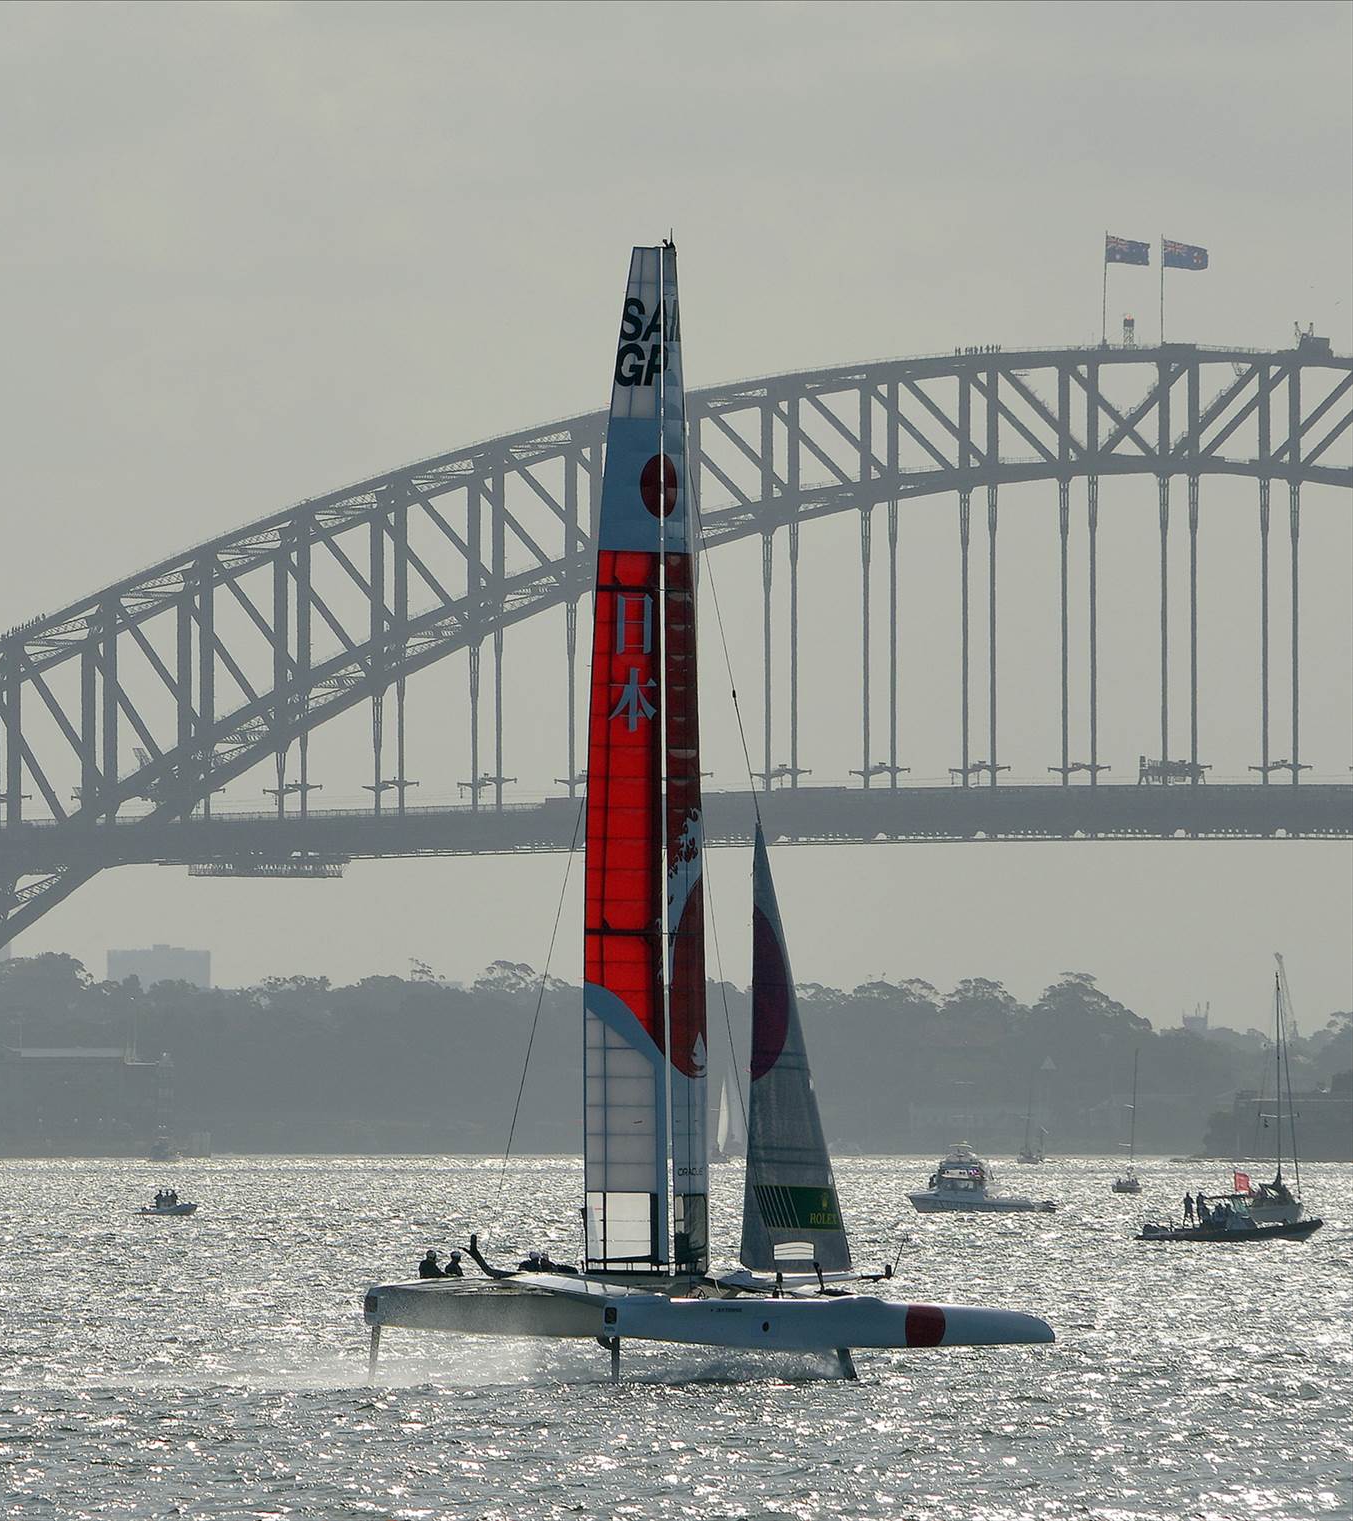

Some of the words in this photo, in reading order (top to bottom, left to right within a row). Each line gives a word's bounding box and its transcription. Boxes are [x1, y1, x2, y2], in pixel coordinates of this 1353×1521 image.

[615, 343, 669, 386] GP
[608, 593, 657, 732] 日本
[809, 1212, 838, 1225] ROLEX
